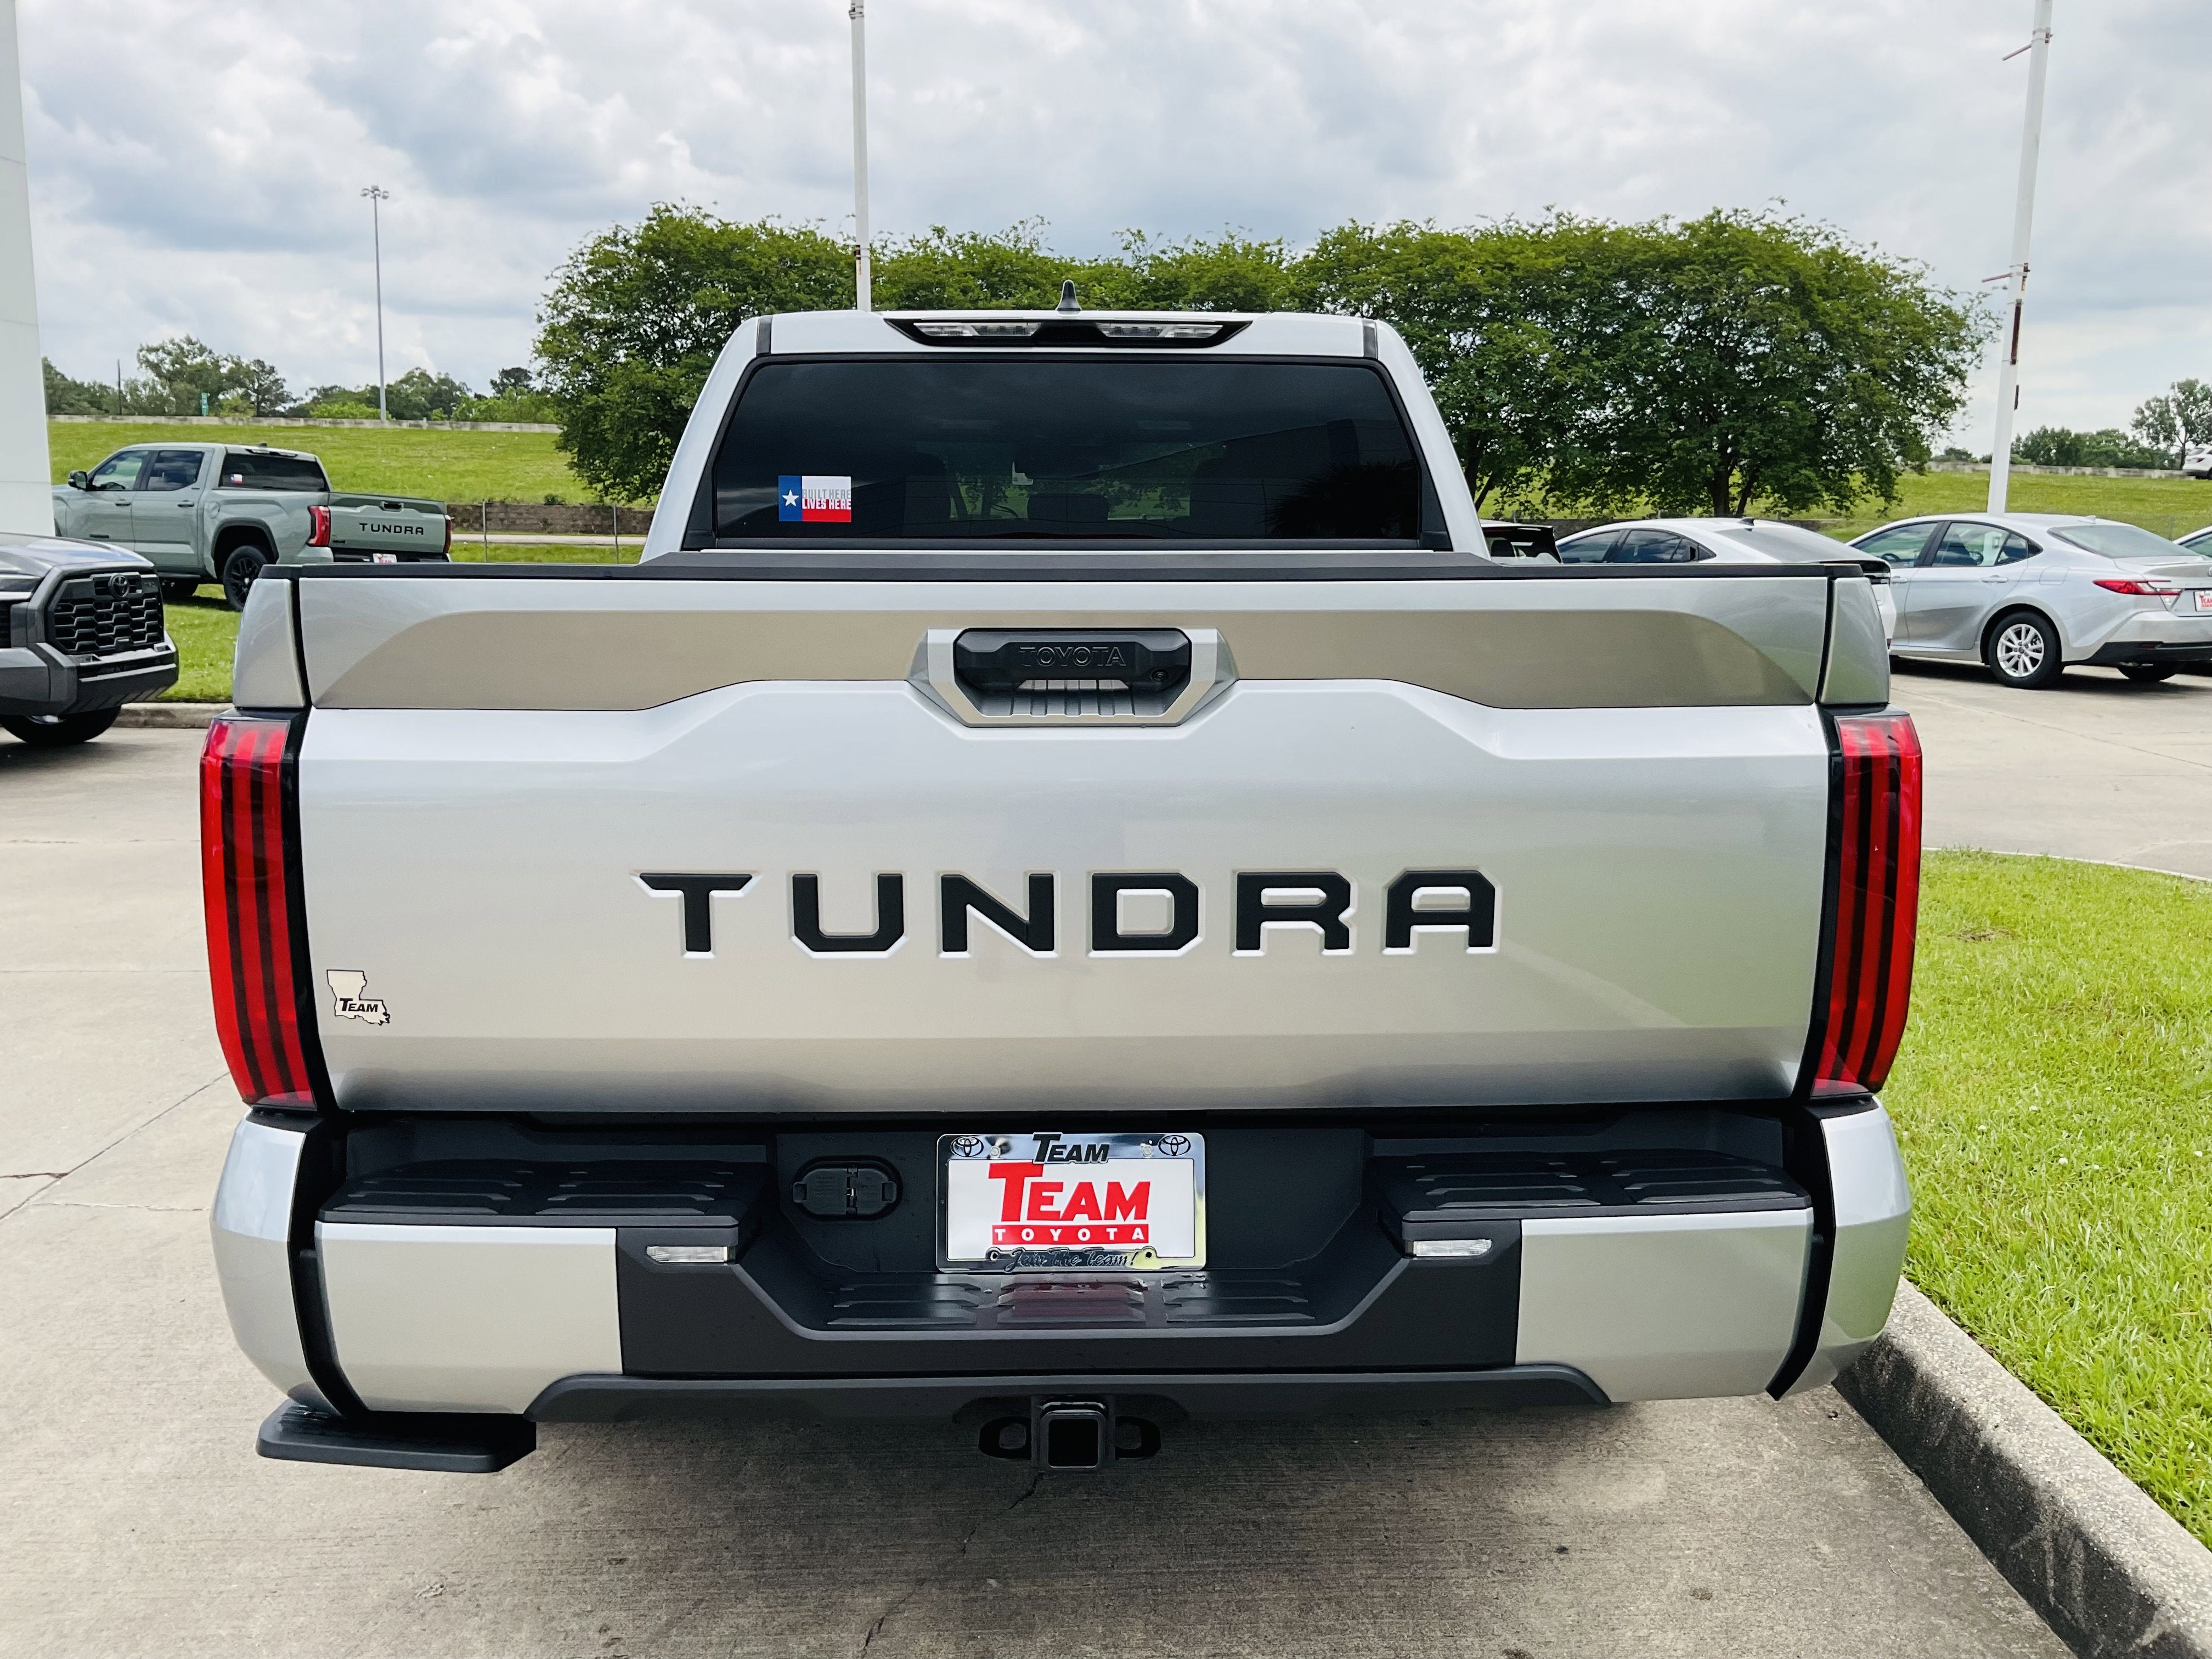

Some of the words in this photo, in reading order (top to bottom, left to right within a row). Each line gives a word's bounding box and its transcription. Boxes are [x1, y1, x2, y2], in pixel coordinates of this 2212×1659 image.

[802, 489, 827, 500] BUILT
[829, 489, 851, 500] HERE
[802, 499, 826, 509] LIVES
[829, 499, 851, 510] HERE
[359, 523, 424, 535] TUNDRA
[1019, 646, 1127, 667] TOYOTA
[635, 870, 1501, 956] TUNDRA
[340, 998, 378, 1012] TEAM
[1032, 1132, 1110, 1164] TEAM
[989, 1163, 1151, 1222] TEAM
[995, 1227, 1144, 1242] TOYOTA
[1003, 1247, 1047, 1273] Join
[1047, 1247, 1082, 1267] The
